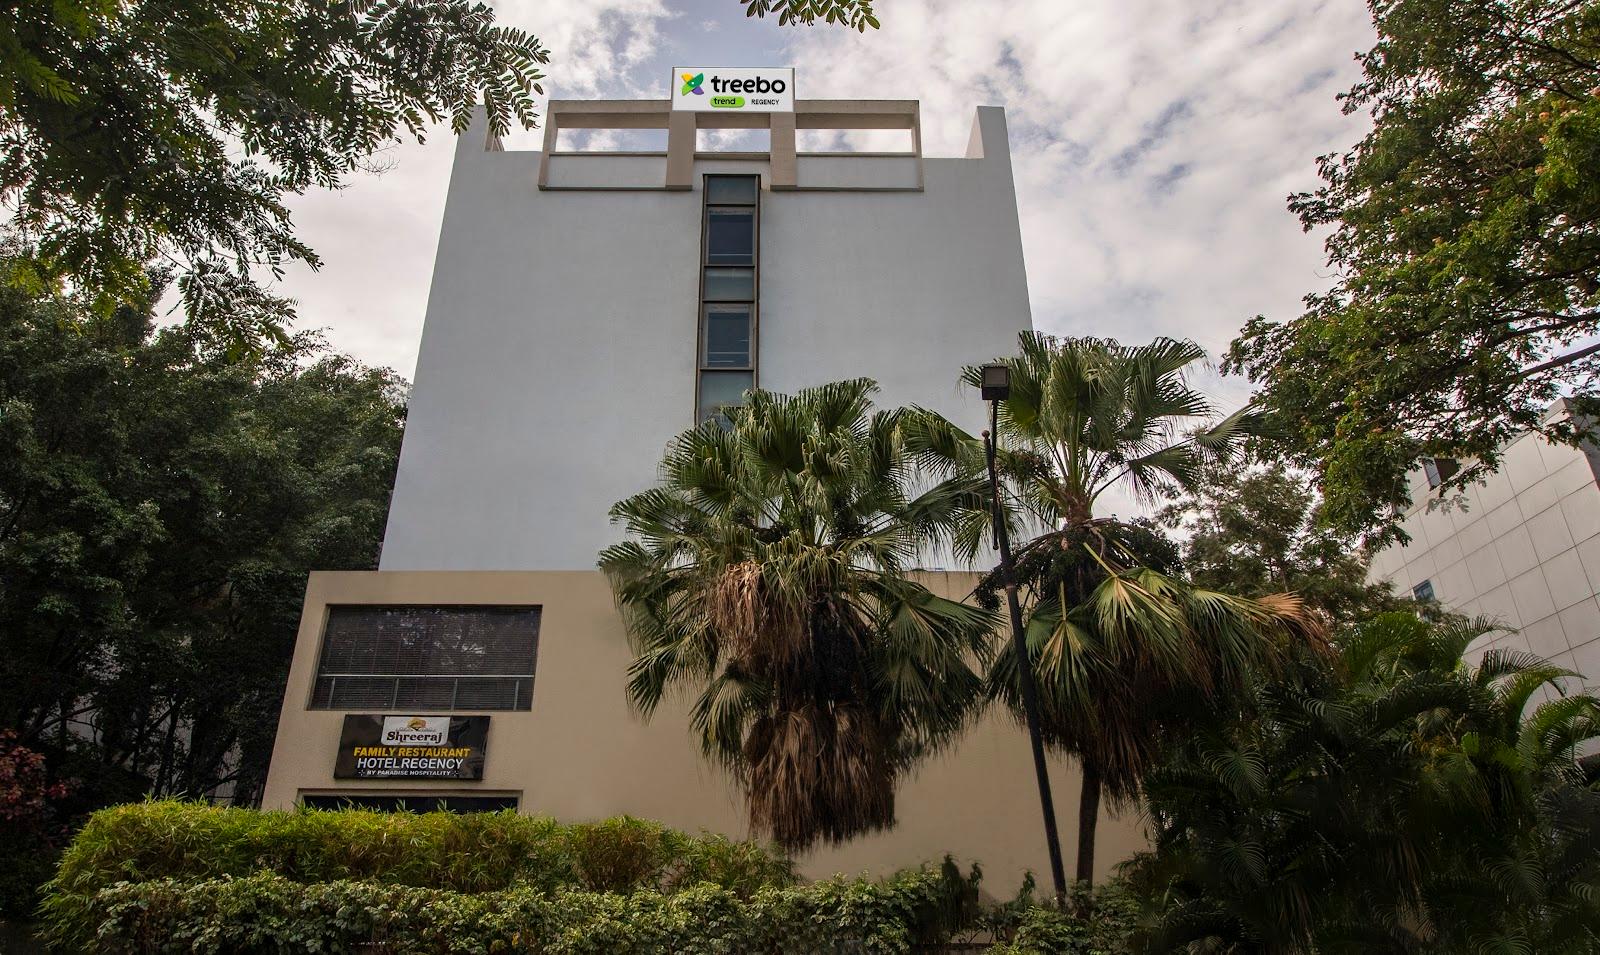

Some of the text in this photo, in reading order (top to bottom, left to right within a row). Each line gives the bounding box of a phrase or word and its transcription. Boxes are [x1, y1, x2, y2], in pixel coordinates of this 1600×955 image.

[710, 75, 786, 94] treebo
[713, 97, 736, 105] trend
[386, 731, 443, 744] Shreeraj
[353, 747, 471, 757] FAMILY RESTAURANT
[357, 757, 464, 769] HOTEL REGENCY
